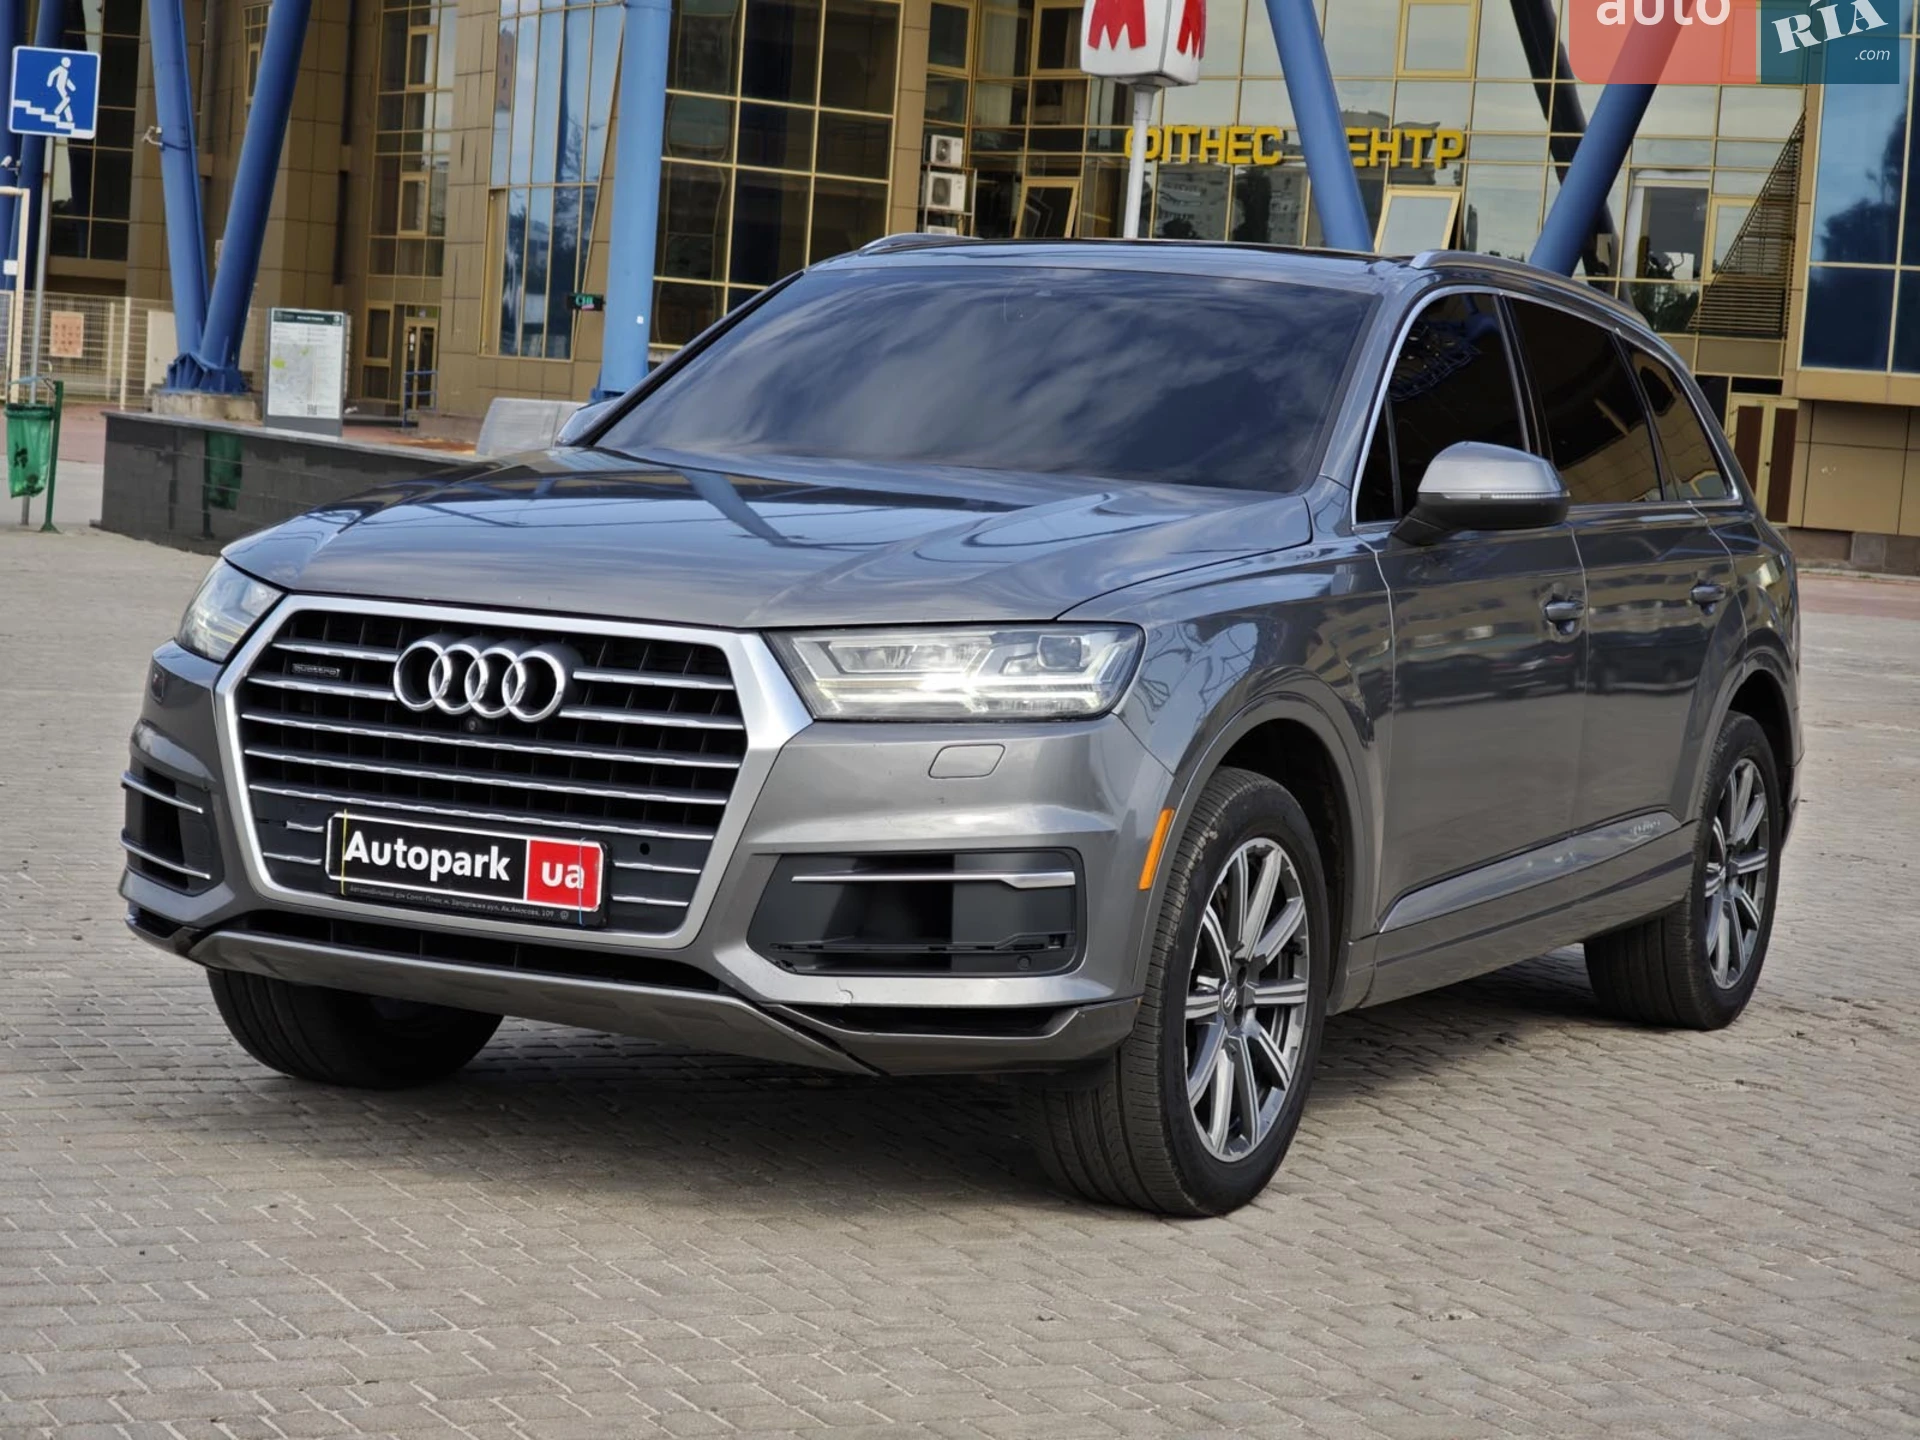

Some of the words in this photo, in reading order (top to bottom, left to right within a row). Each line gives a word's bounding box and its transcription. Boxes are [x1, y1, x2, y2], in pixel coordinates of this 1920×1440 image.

[1344, 128, 1465, 169] ЕНТР
[344, 830, 510, 881] Autopark
[541, 861, 585, 889] ua
